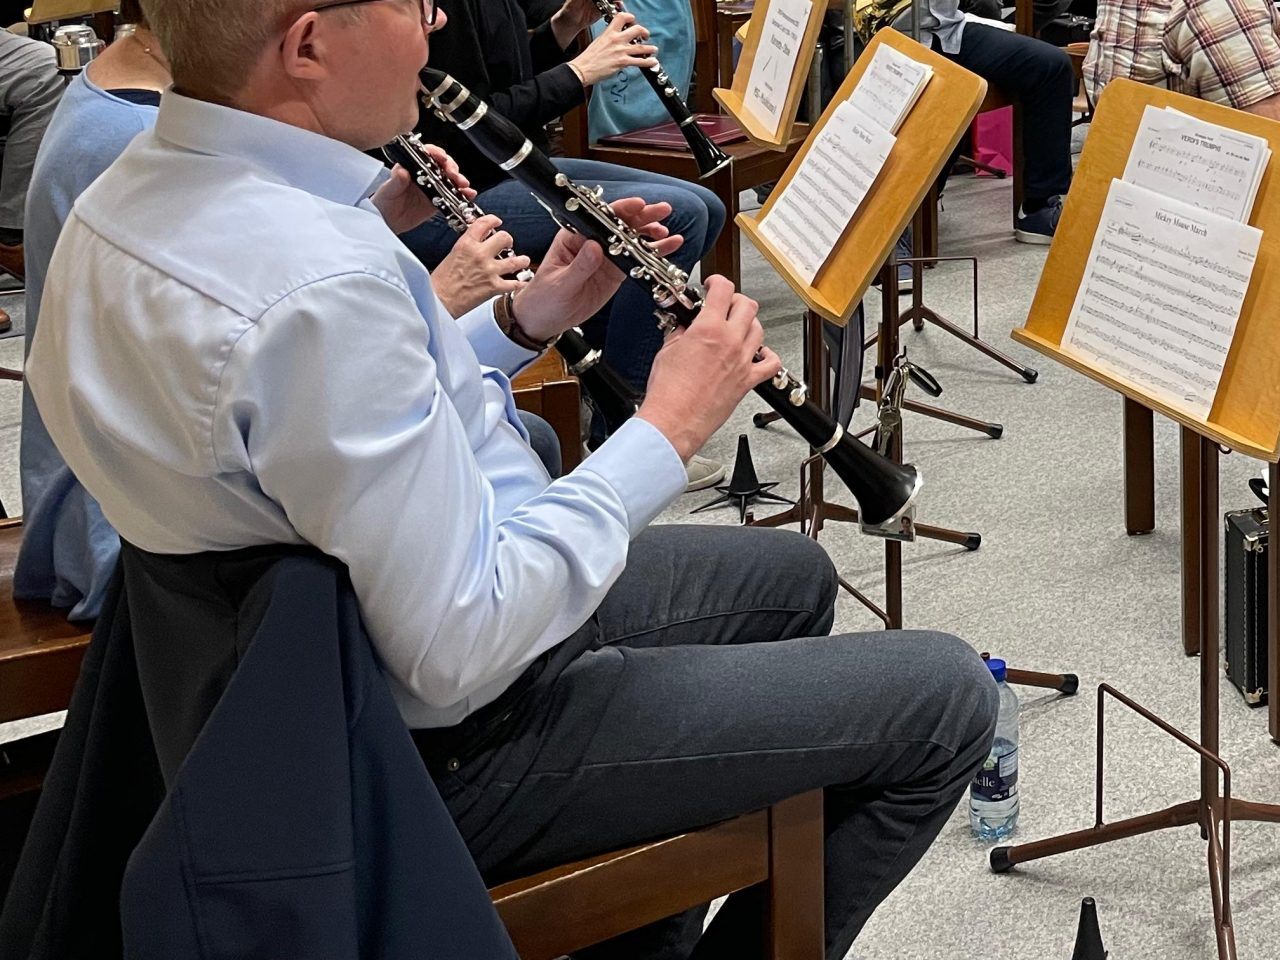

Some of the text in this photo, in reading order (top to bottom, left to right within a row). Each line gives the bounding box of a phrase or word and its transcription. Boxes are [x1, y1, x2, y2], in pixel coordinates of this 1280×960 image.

[1155, 211, 1173, 226] Mickey
[1173, 217, 1189, 231] Mouse
[1190, 224, 1208, 238] March
